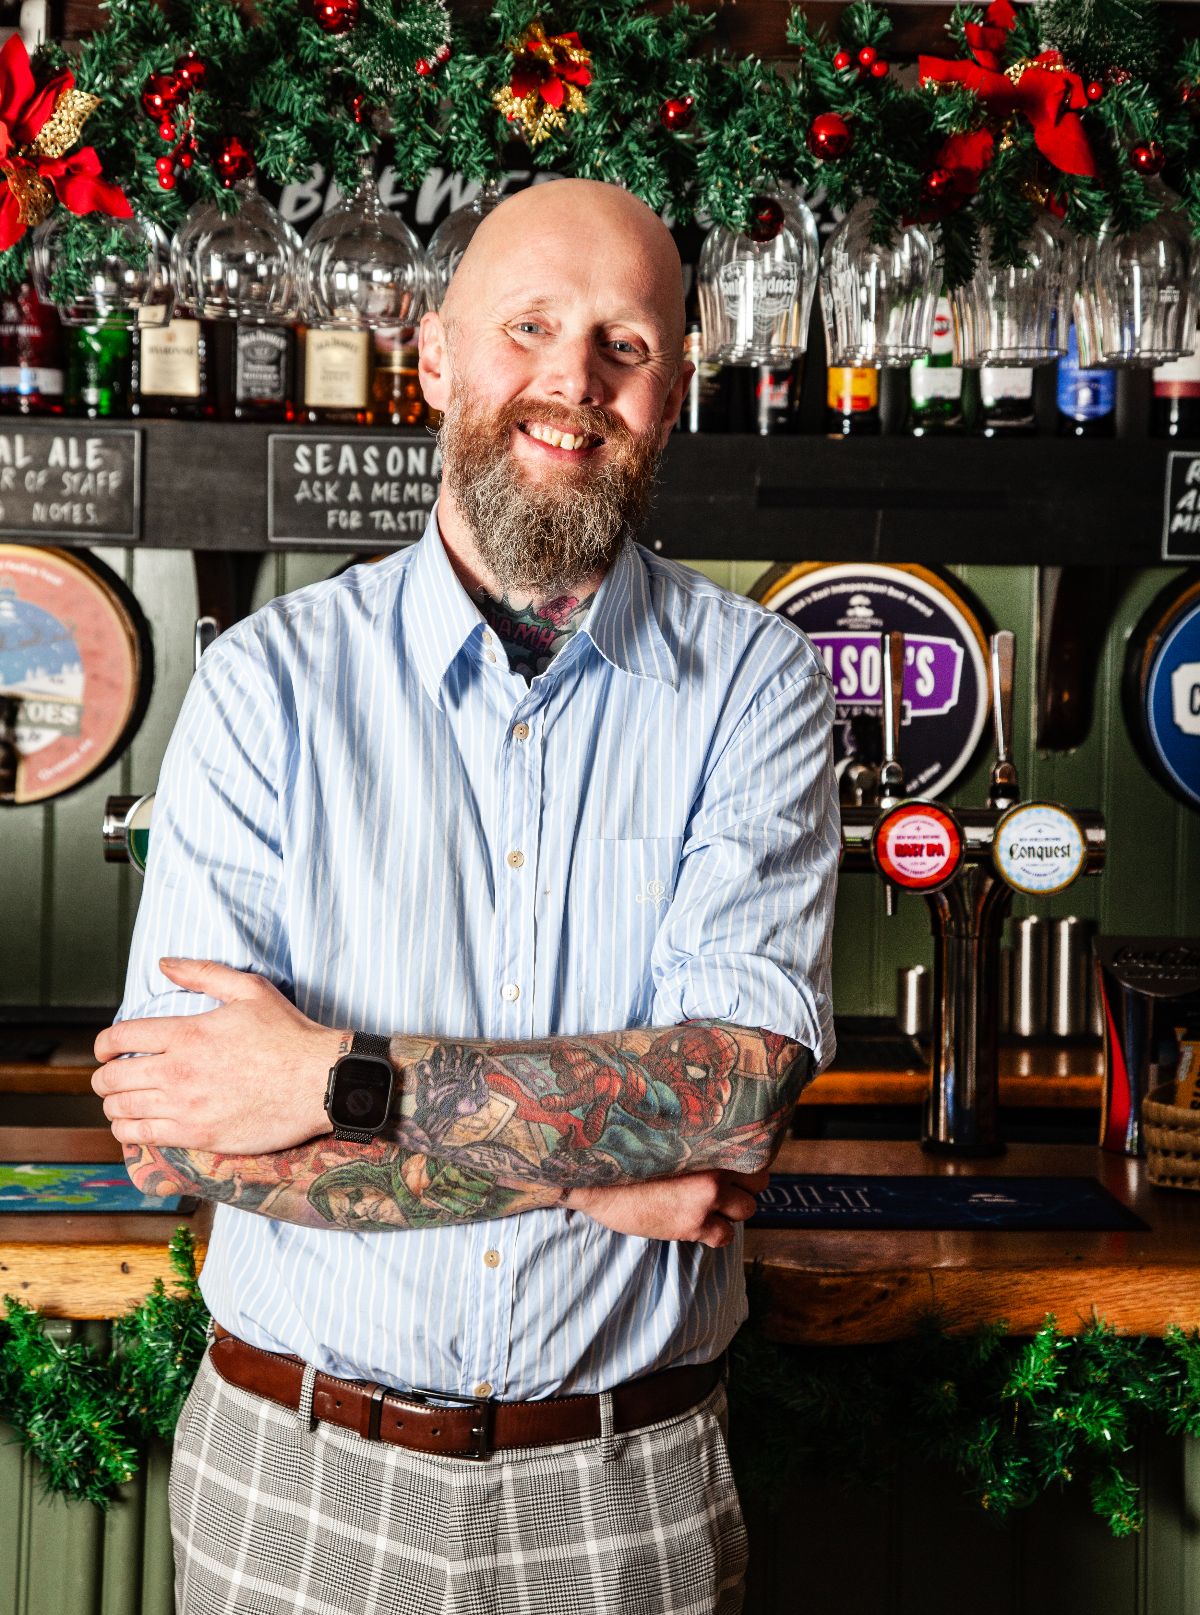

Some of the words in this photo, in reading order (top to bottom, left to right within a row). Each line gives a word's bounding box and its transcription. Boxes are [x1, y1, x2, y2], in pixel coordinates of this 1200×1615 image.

[48, 436, 104, 470] ALE
[24, 469, 48, 494] OF
[61, 469, 121, 497] STAFF
[293, 478, 340, 505] ASK
[346, 479, 364, 503] A
[370, 480, 441, 505] MEMB
[32, 501, 99, 526] NOTES
[18, 700, 77, 727] OES
[926, 843, 945, 857] IPA
[1009, 842, 1071, 861] Conquest
